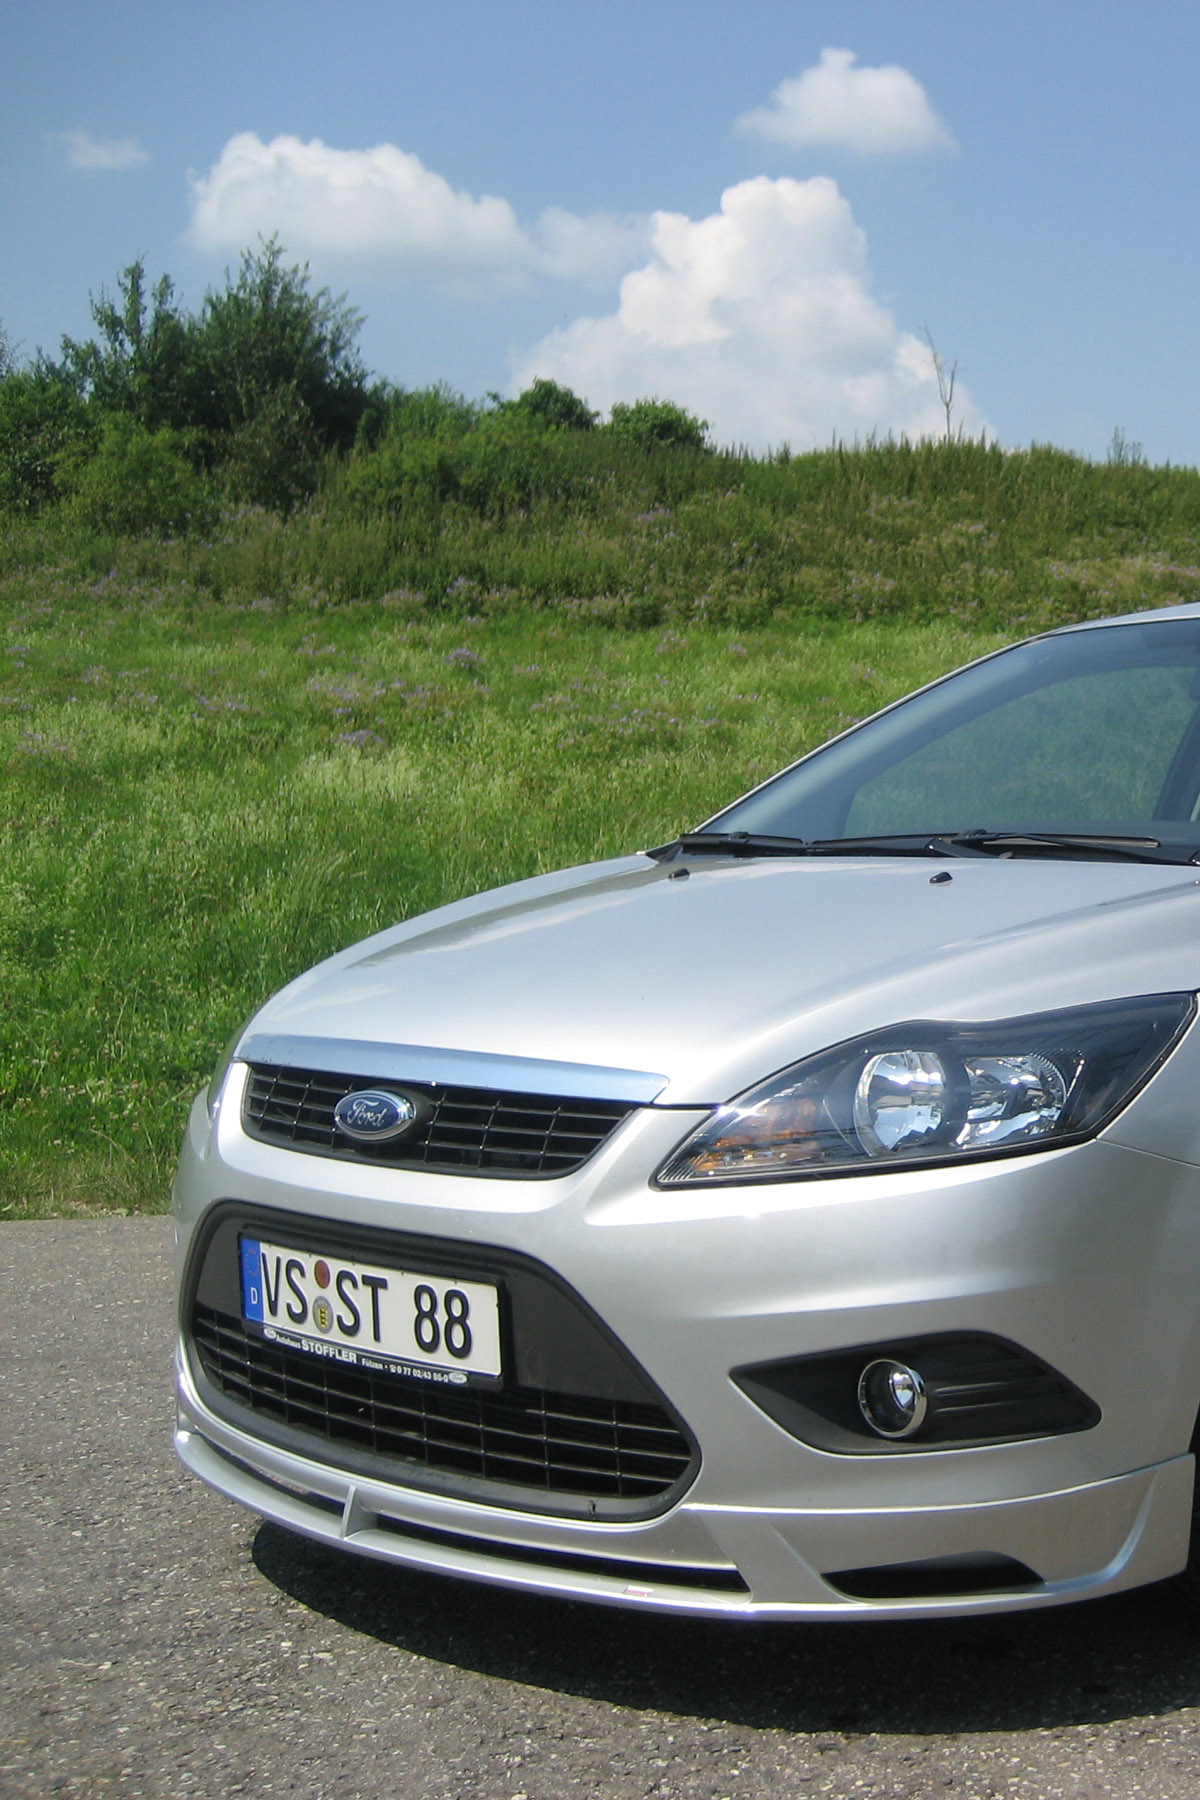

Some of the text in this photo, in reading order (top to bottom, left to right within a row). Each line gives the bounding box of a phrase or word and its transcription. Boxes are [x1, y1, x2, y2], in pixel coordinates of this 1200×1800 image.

[346, 1098, 388, 1127] Ford
[250, 1287, 259, 1305] D
[261, 1251, 473, 1359] VS ST 88
[301, 1338, 358, 1364] STOFFLER
